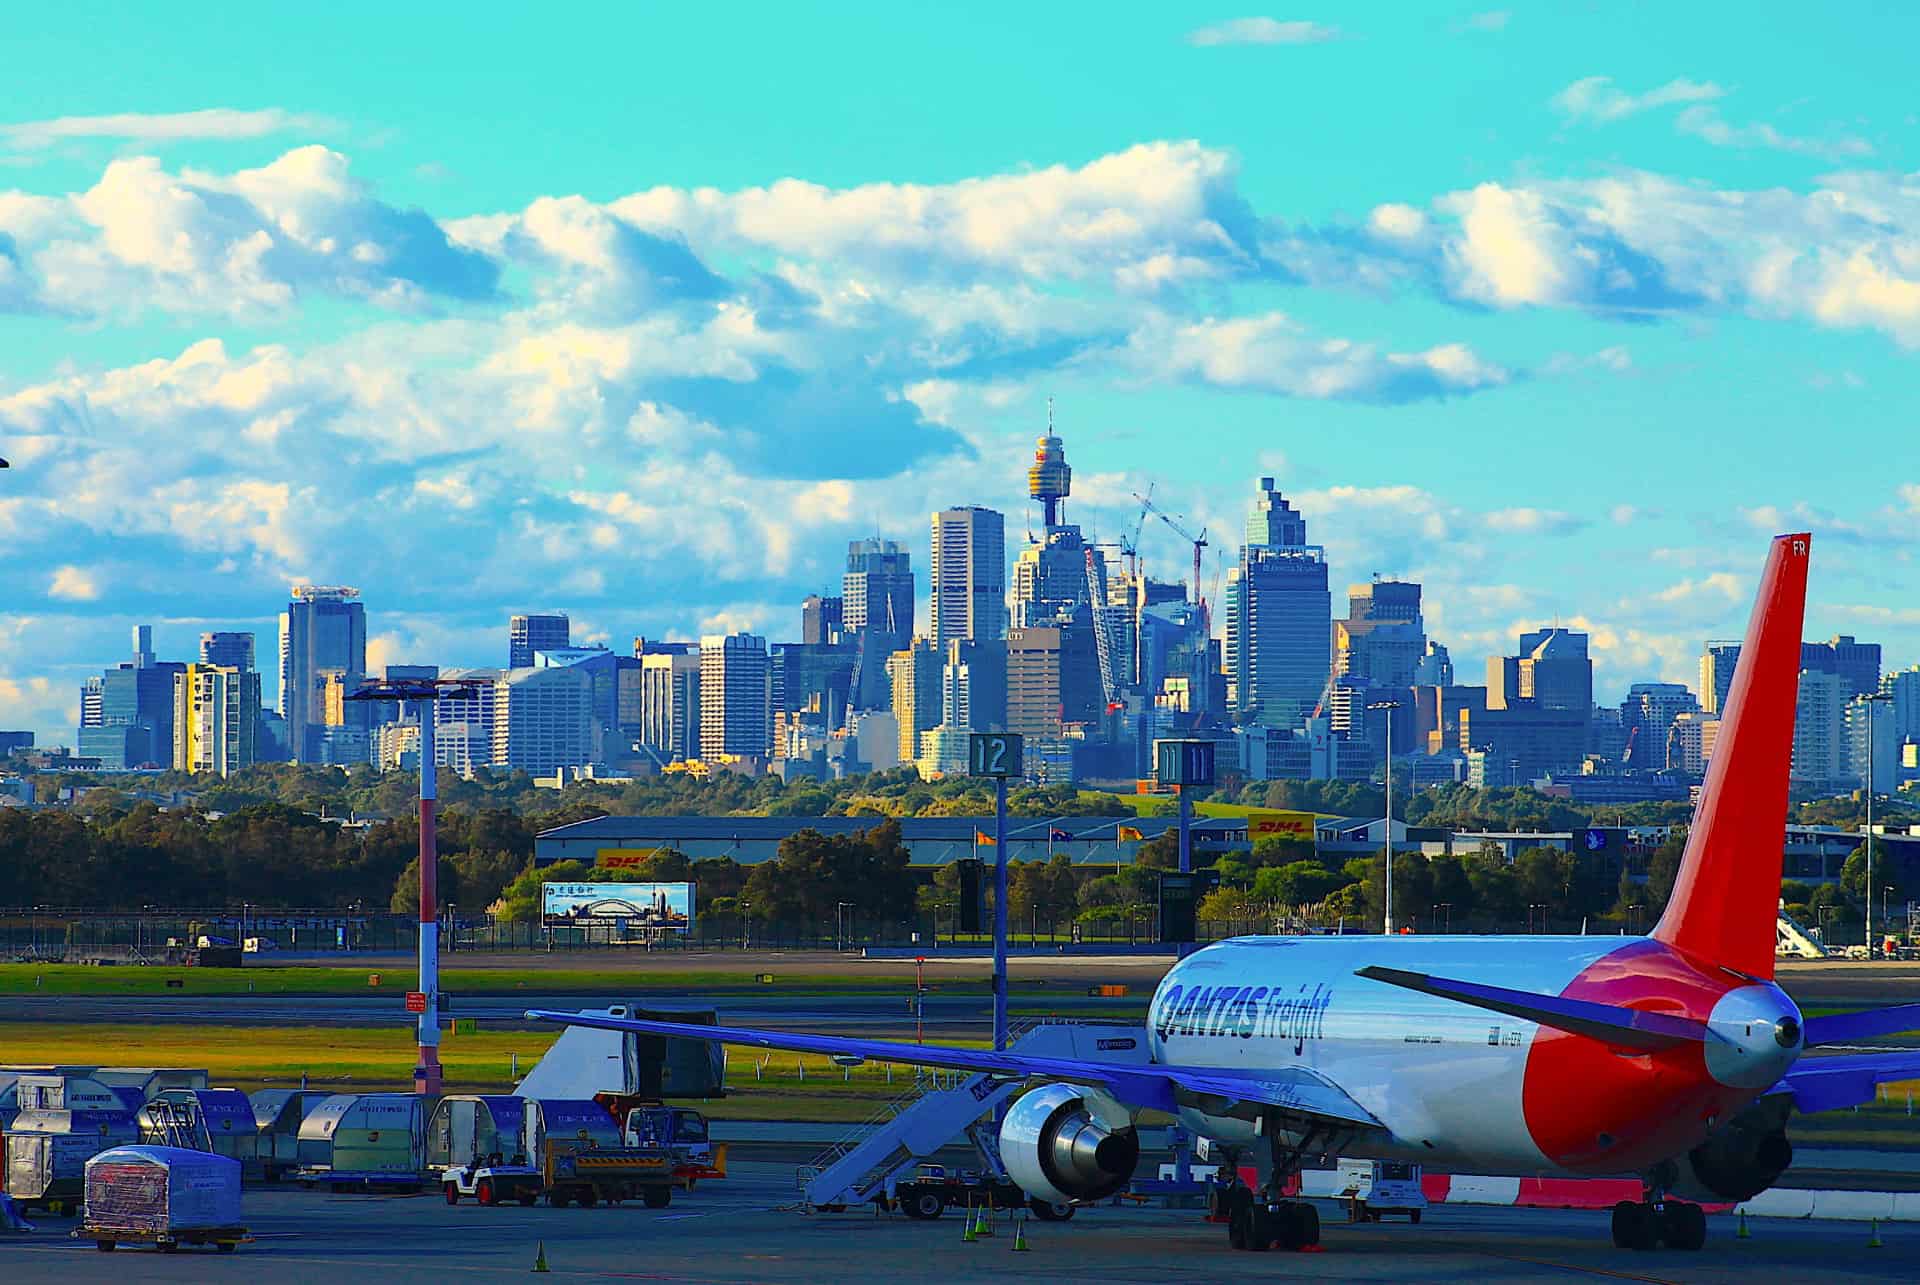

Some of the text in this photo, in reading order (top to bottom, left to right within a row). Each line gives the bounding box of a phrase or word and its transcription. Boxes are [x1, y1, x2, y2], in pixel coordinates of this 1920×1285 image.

[1793, 540, 1806, 556] FR
[978, 738, 1006, 772] 12
[1164, 748, 1176, 780] 11
[1257, 821, 1304, 832] DHL
[1156, 982, 1333, 1056] QANTAS Freight
